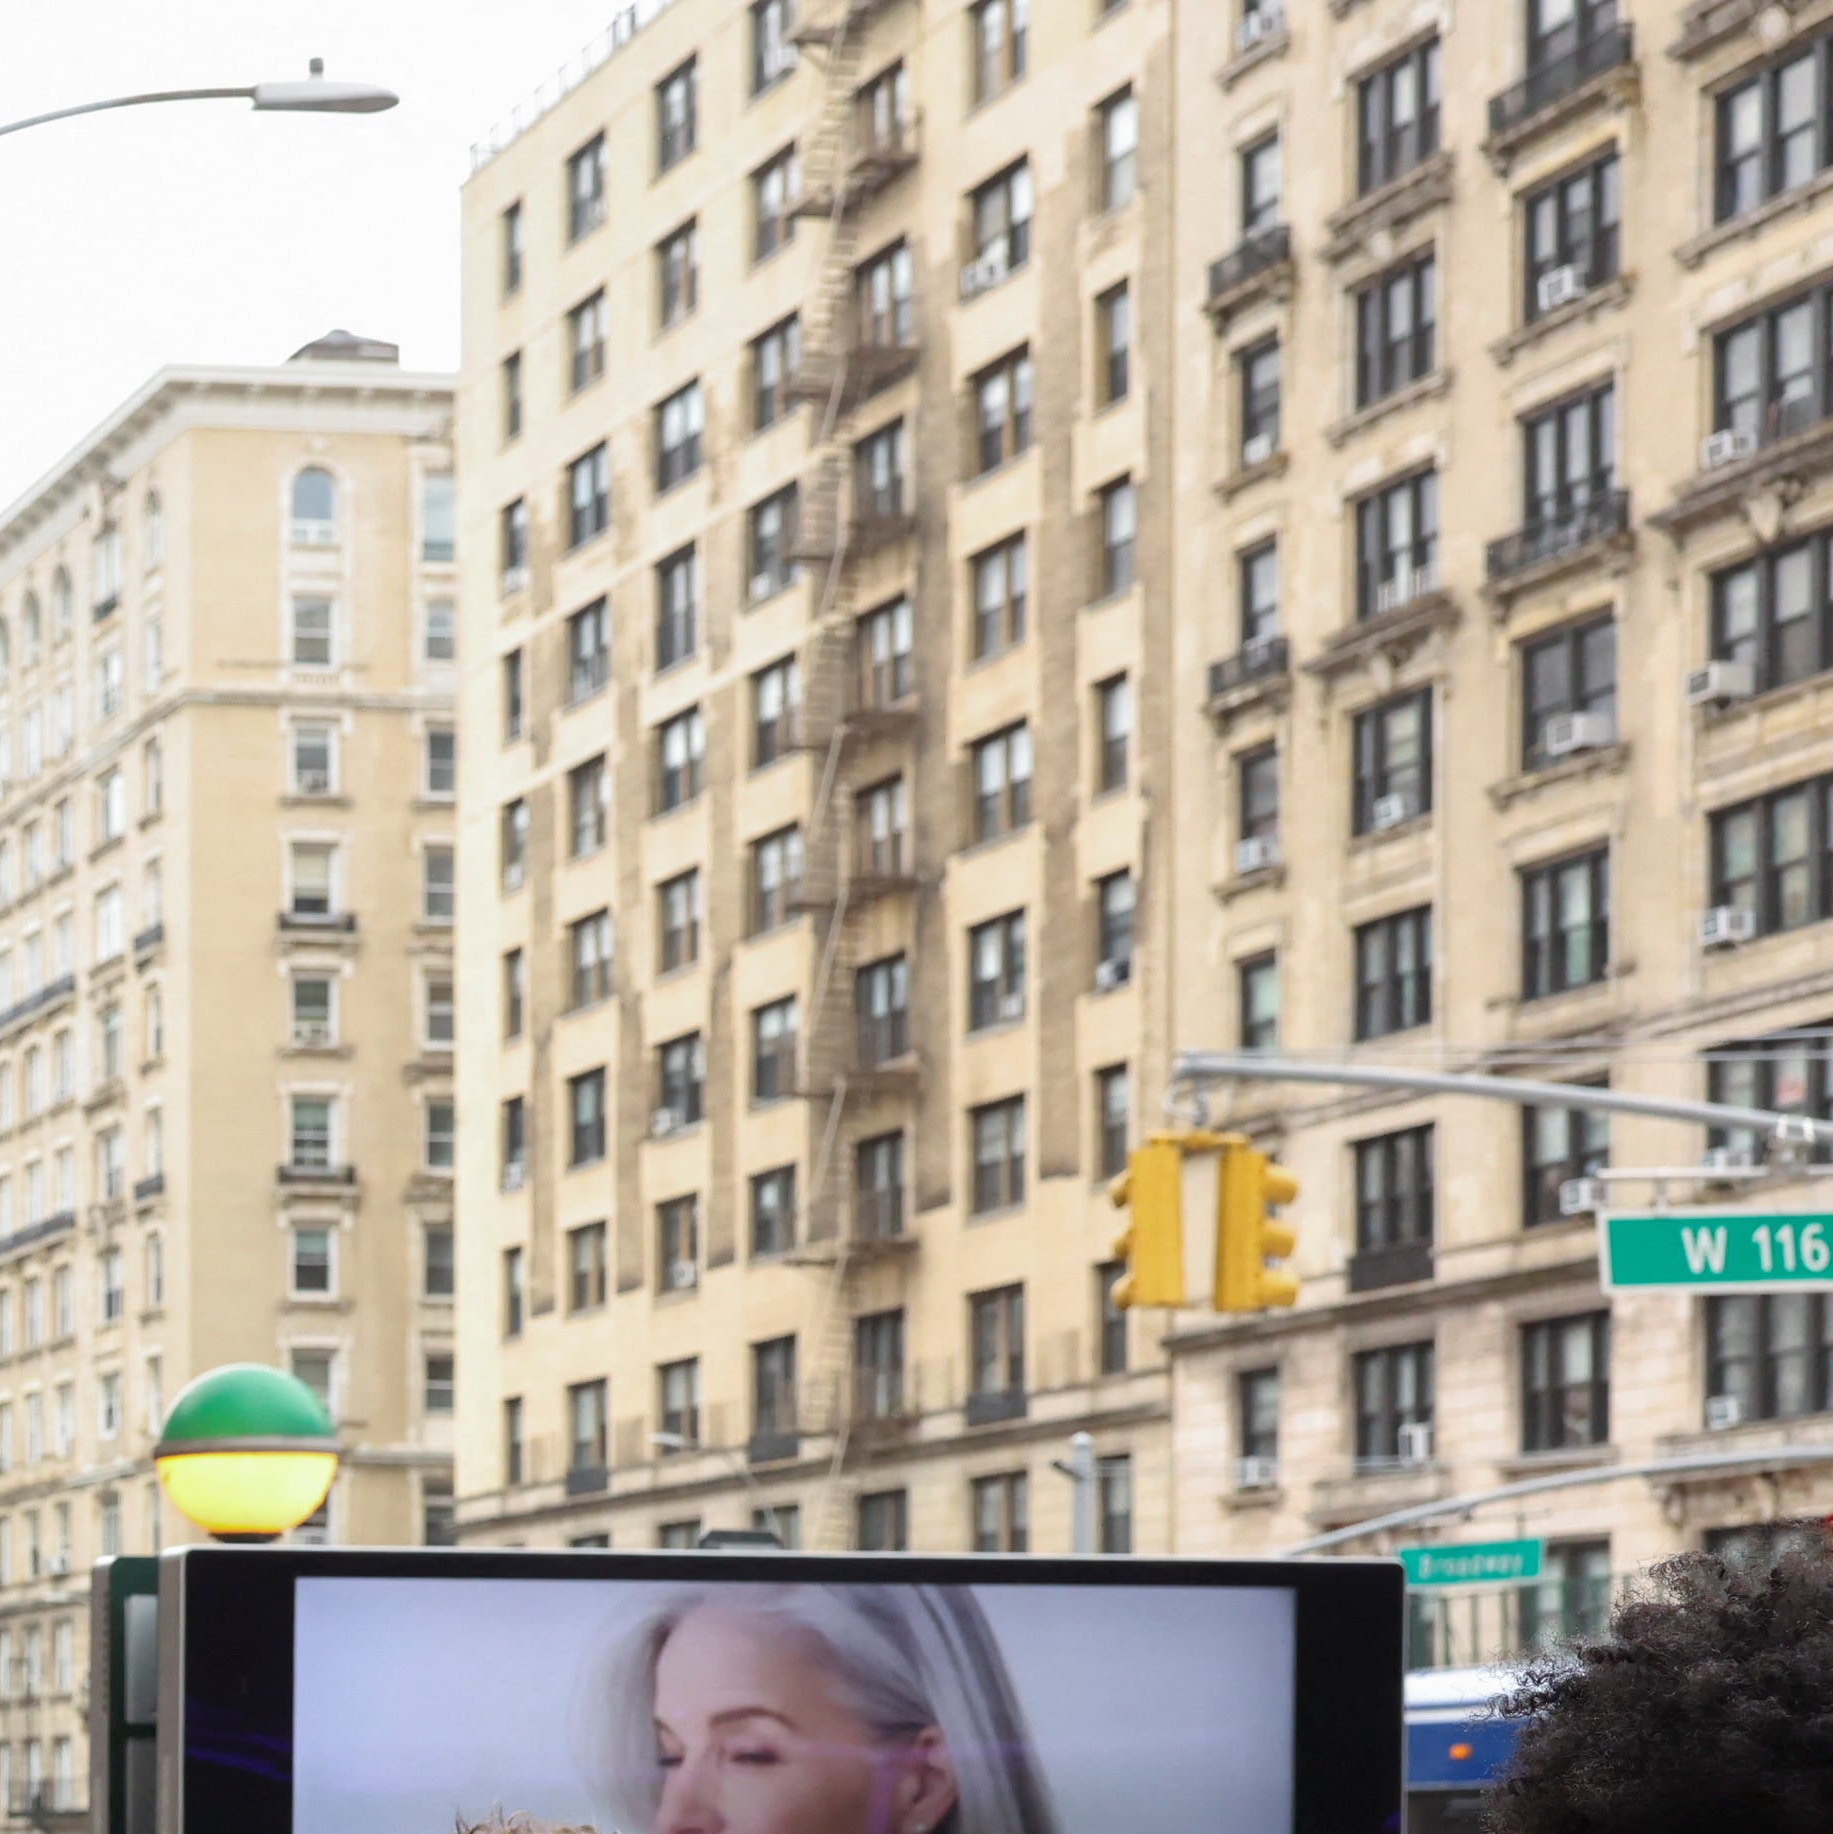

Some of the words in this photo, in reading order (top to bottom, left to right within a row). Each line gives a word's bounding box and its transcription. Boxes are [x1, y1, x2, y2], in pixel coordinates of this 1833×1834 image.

[1681, 1226, 1728, 1274] W
[1752, 1222, 1831, 1273] 116
[1419, 1553, 1523, 1580] Broadway
